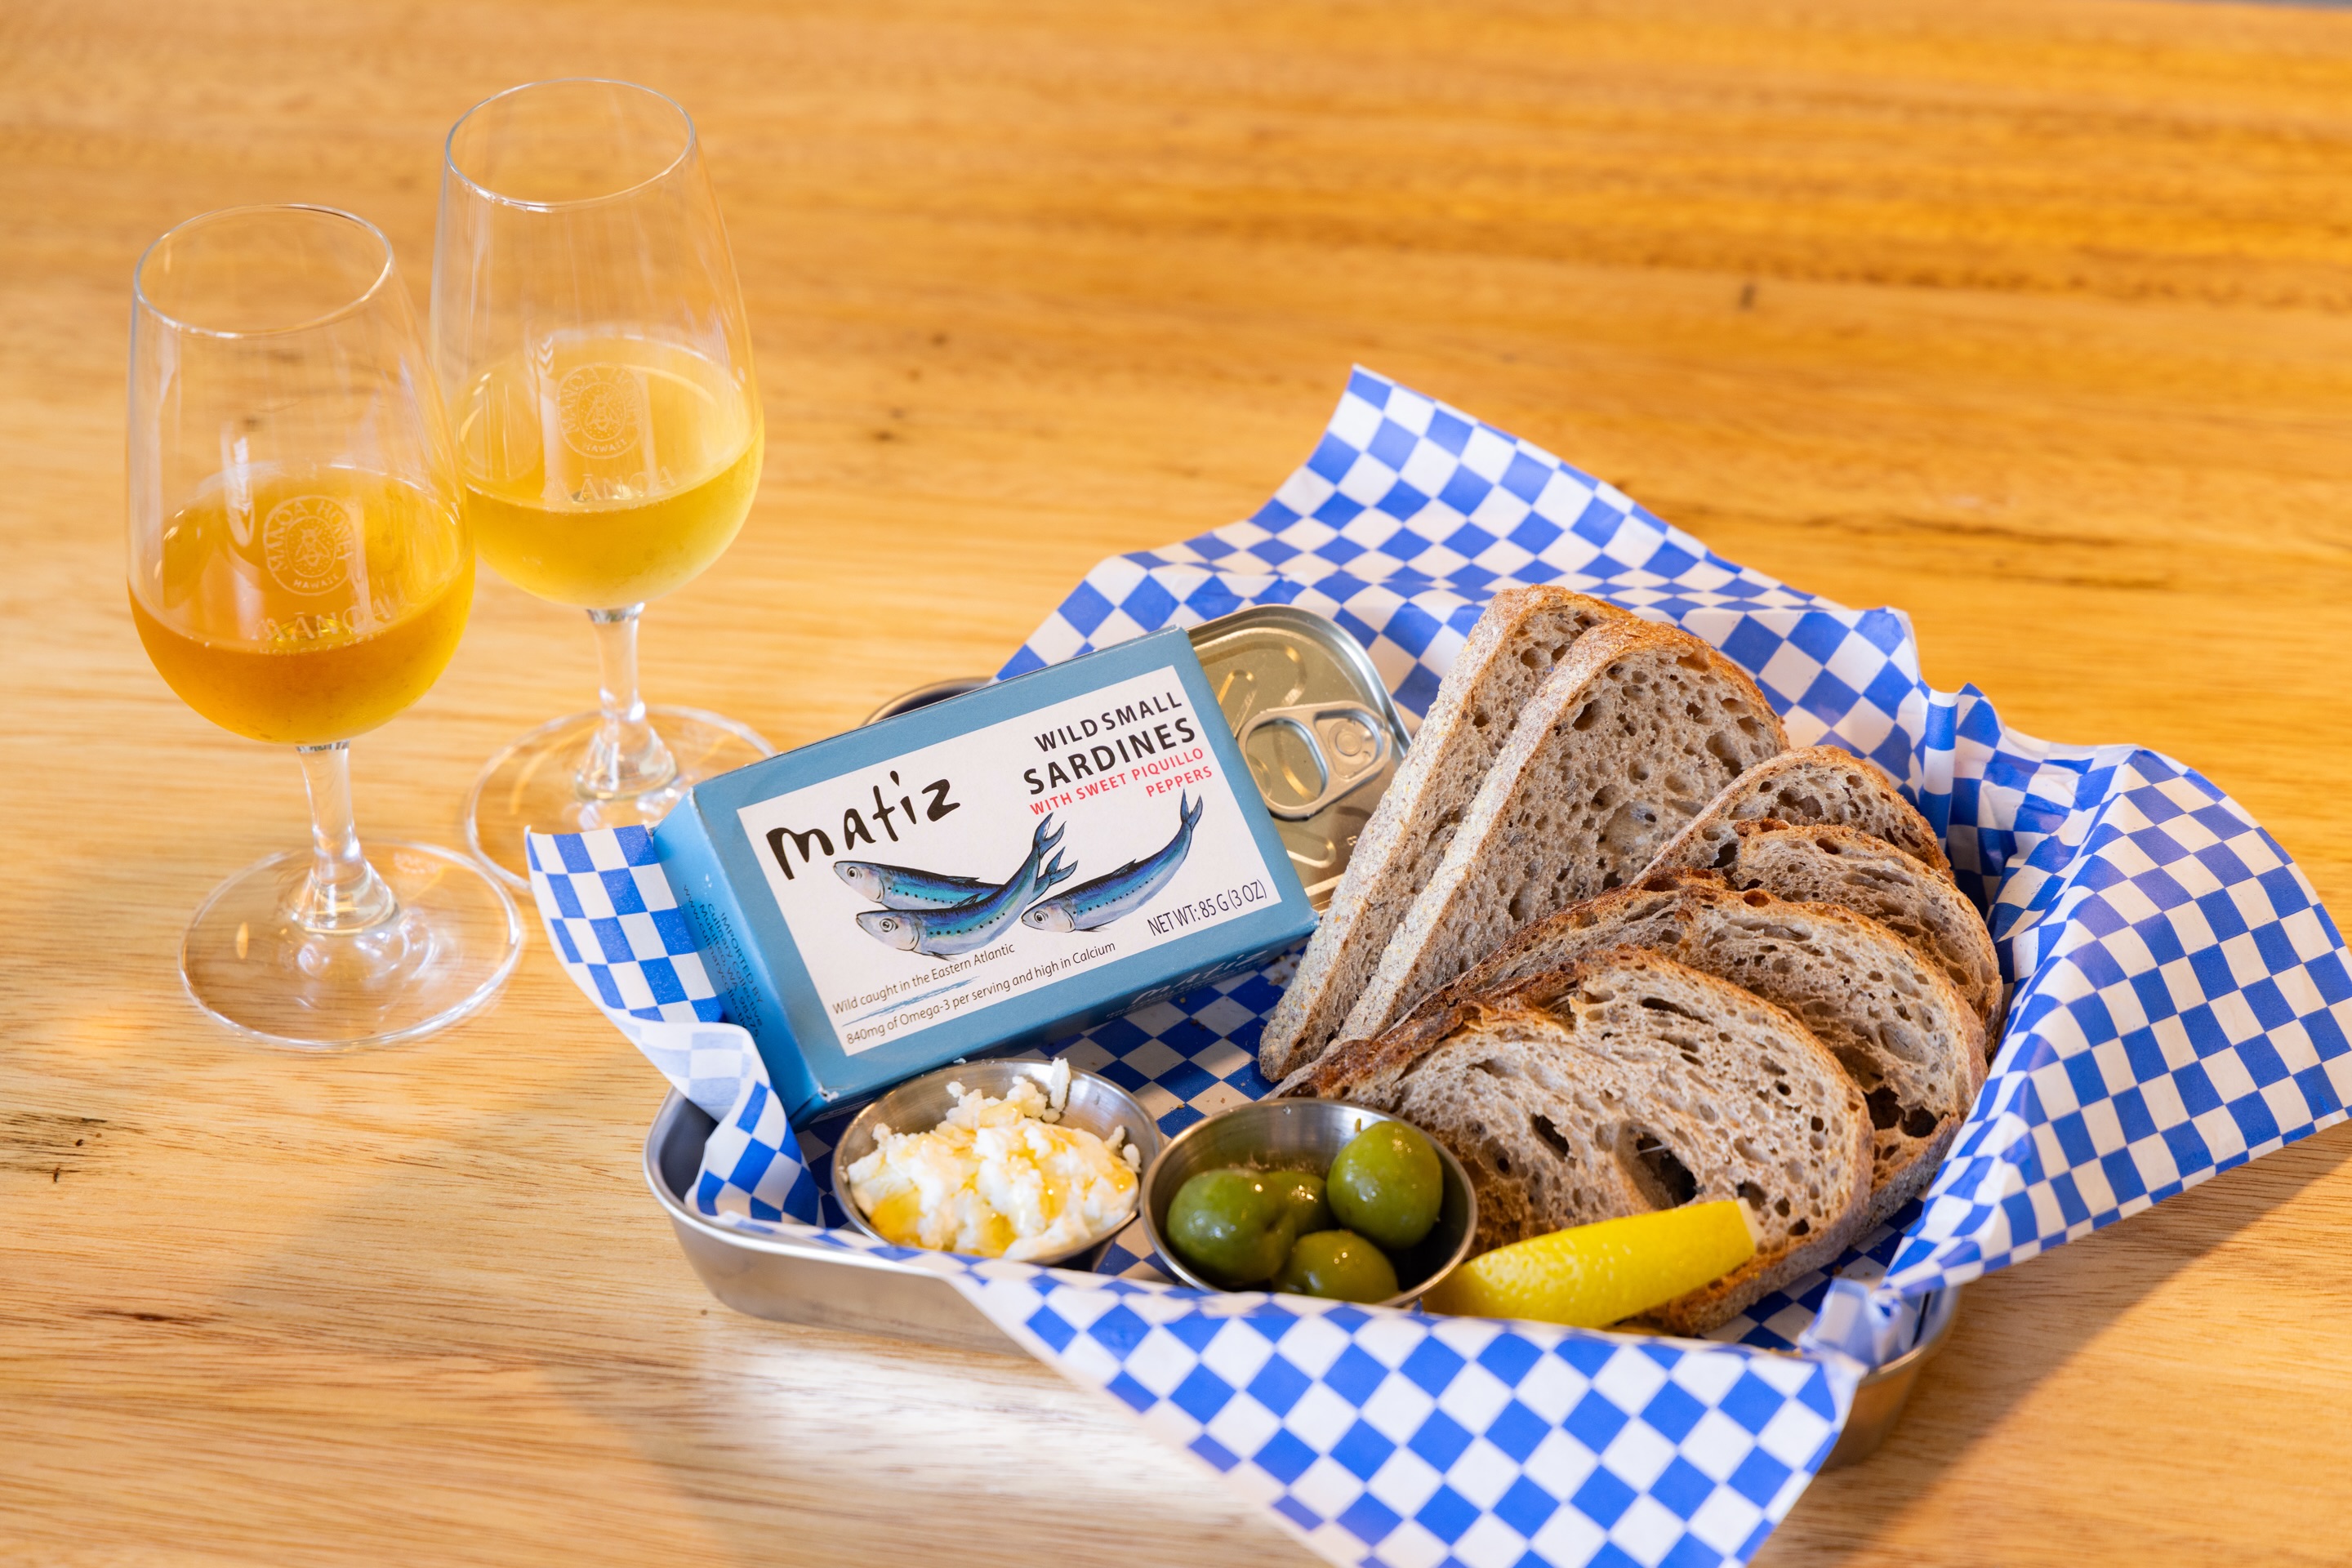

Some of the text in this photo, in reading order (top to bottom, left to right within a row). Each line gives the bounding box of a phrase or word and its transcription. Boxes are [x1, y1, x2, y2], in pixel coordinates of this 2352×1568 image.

[293, 573, 340, 589] HAWAII
[1023, 717, 1196, 795] SARDINES
[1034, 692, 1183, 752] WILD SMALL
[1030, 747, 1204, 816] WITH SWEET PIQUILLO
[1146, 766, 1213, 797] PEPPERS
[766, 770, 960, 880] matiz
[1147, 879, 1267, 937] NET WT: 85 G (3 OZ)
[684, 884, 746, 1029] www.culinarycollectiv
[708, 903, 763, 1027] Culinary Collective
[720, 912, 764, 1003] IMPORTED BY
[832, 943, 1015, 1014] Wild caught in the Eastern Atlantic
[727, 967, 738, 991] WA
[739, 996, 760, 1037] 98275
[846, 942, 1116, 1045] 840mg of Omega-3 per serving and high in Calcium
